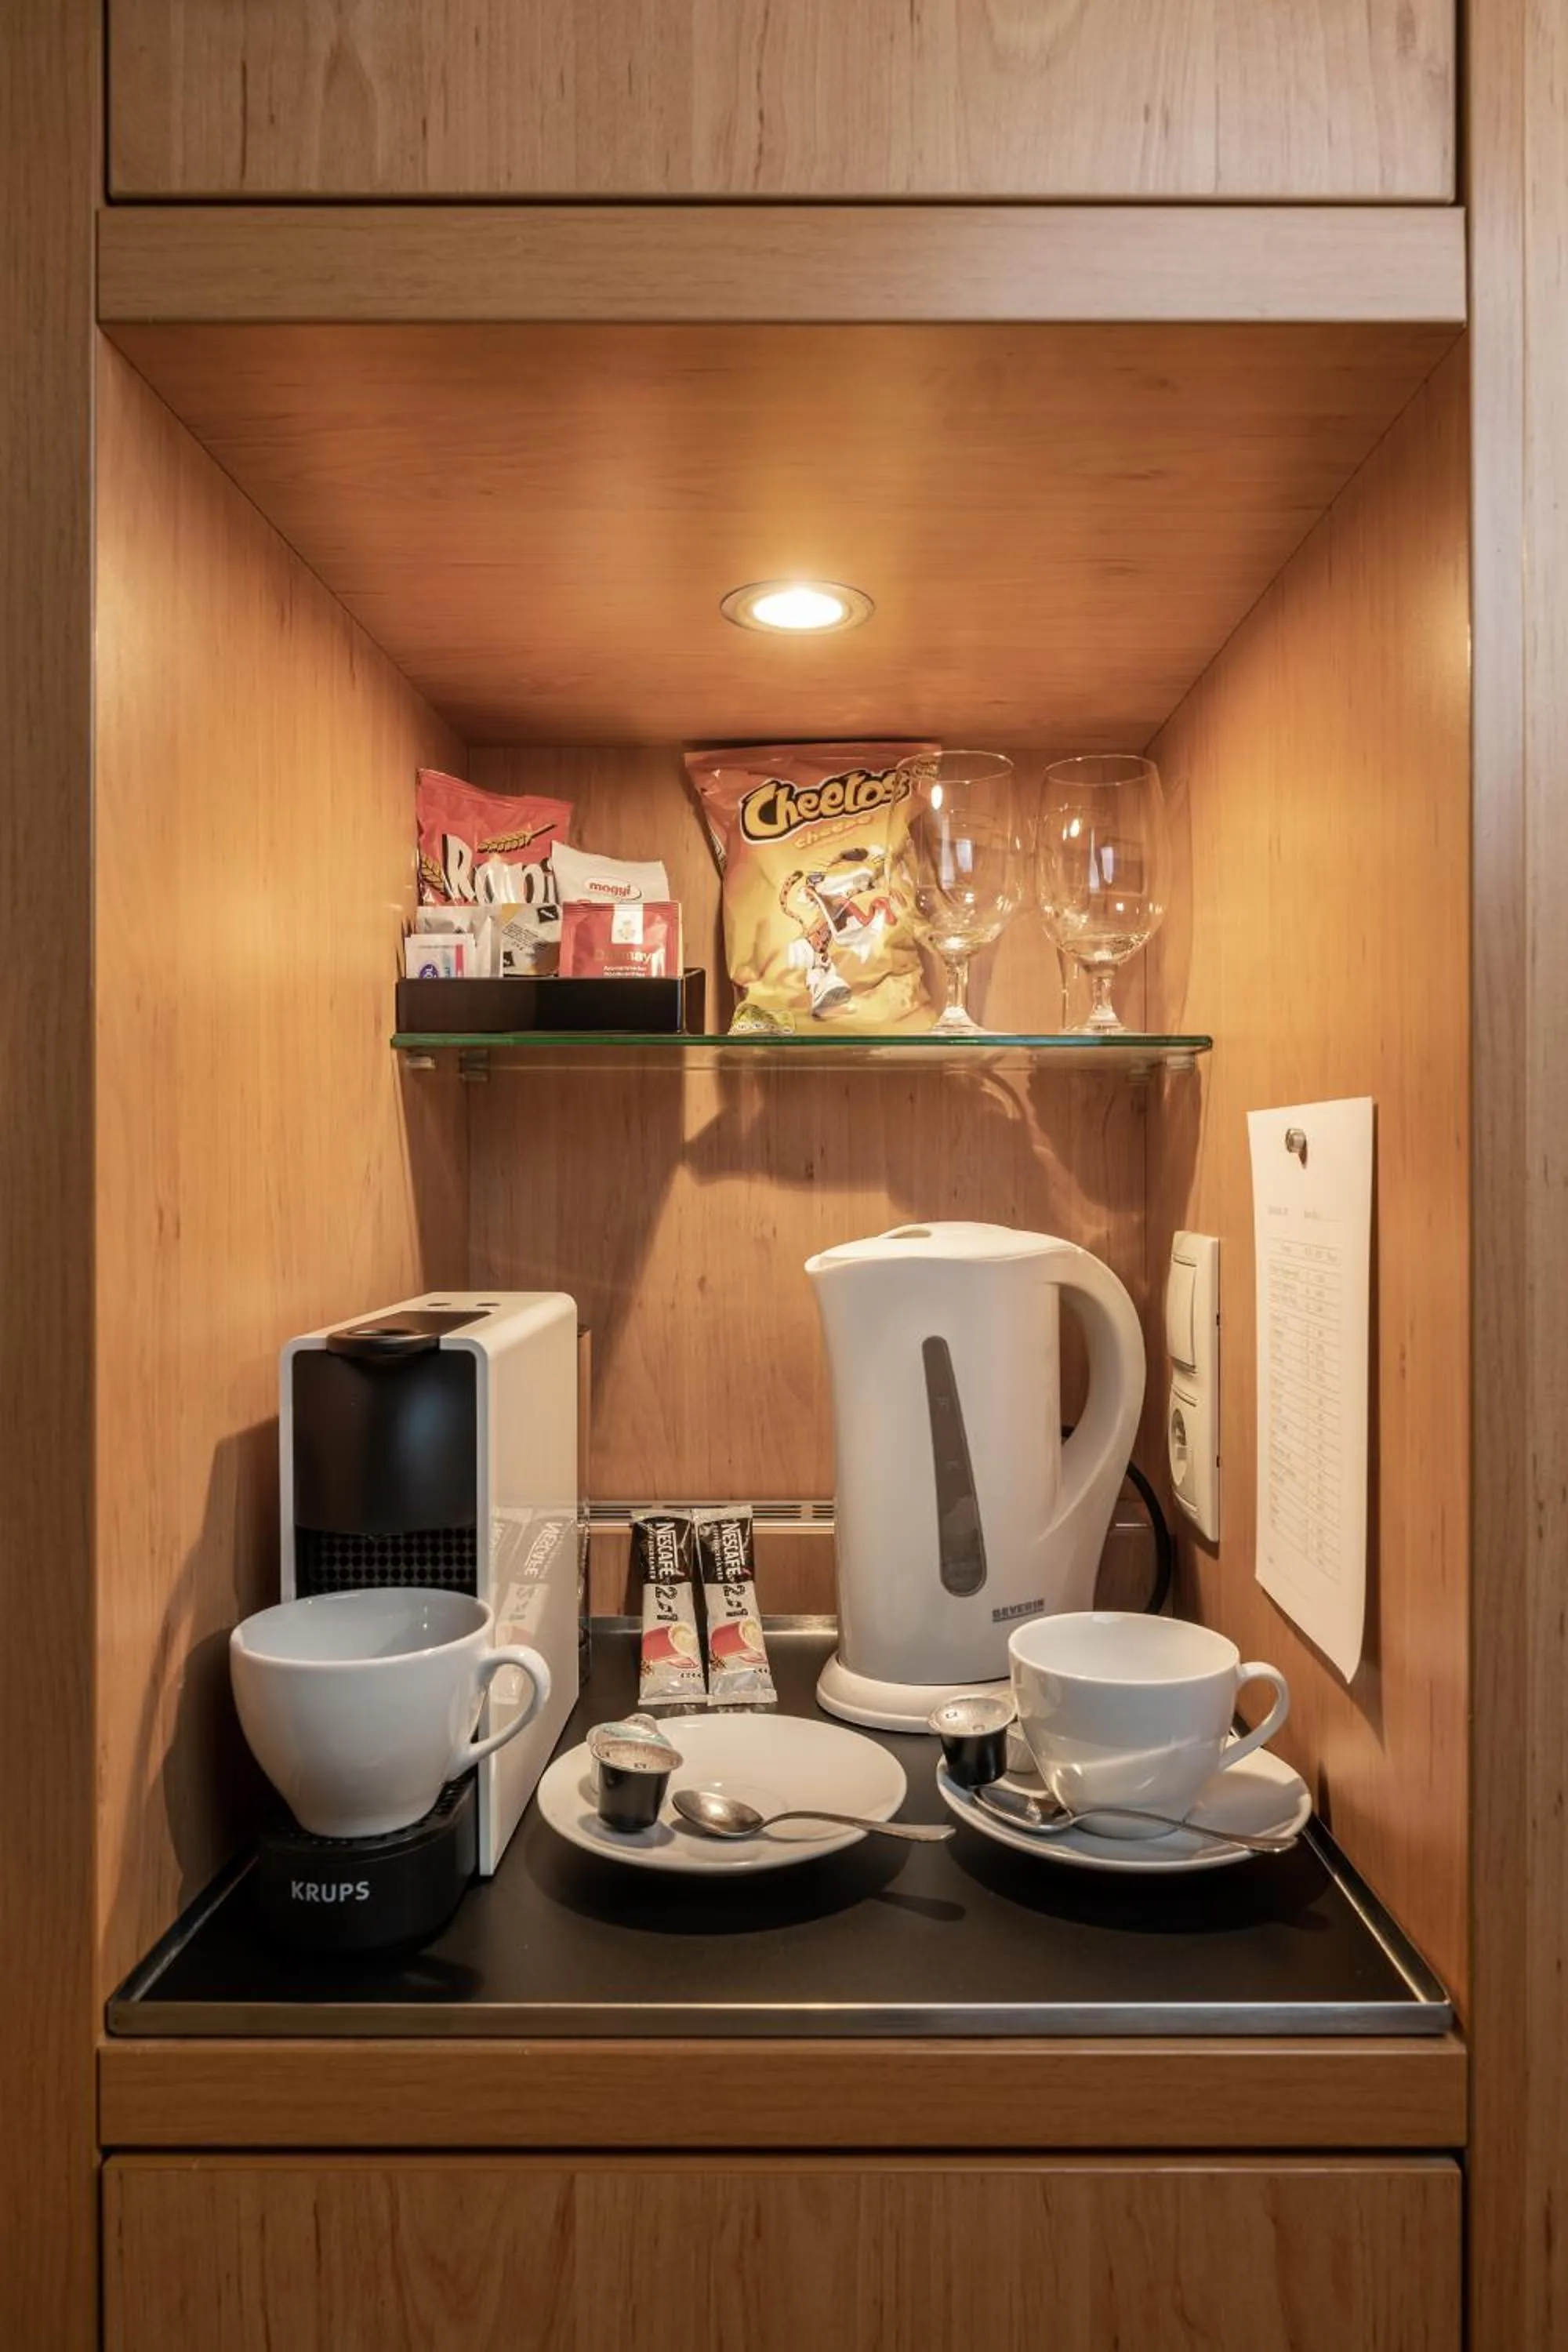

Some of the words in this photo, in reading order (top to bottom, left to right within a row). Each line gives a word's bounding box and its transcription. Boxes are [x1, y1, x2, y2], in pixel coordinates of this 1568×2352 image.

[743, 769, 911, 839] Cheetos
[588, 881, 632, 897] mogyi
[290, 1880, 371, 1903] KRUPS
